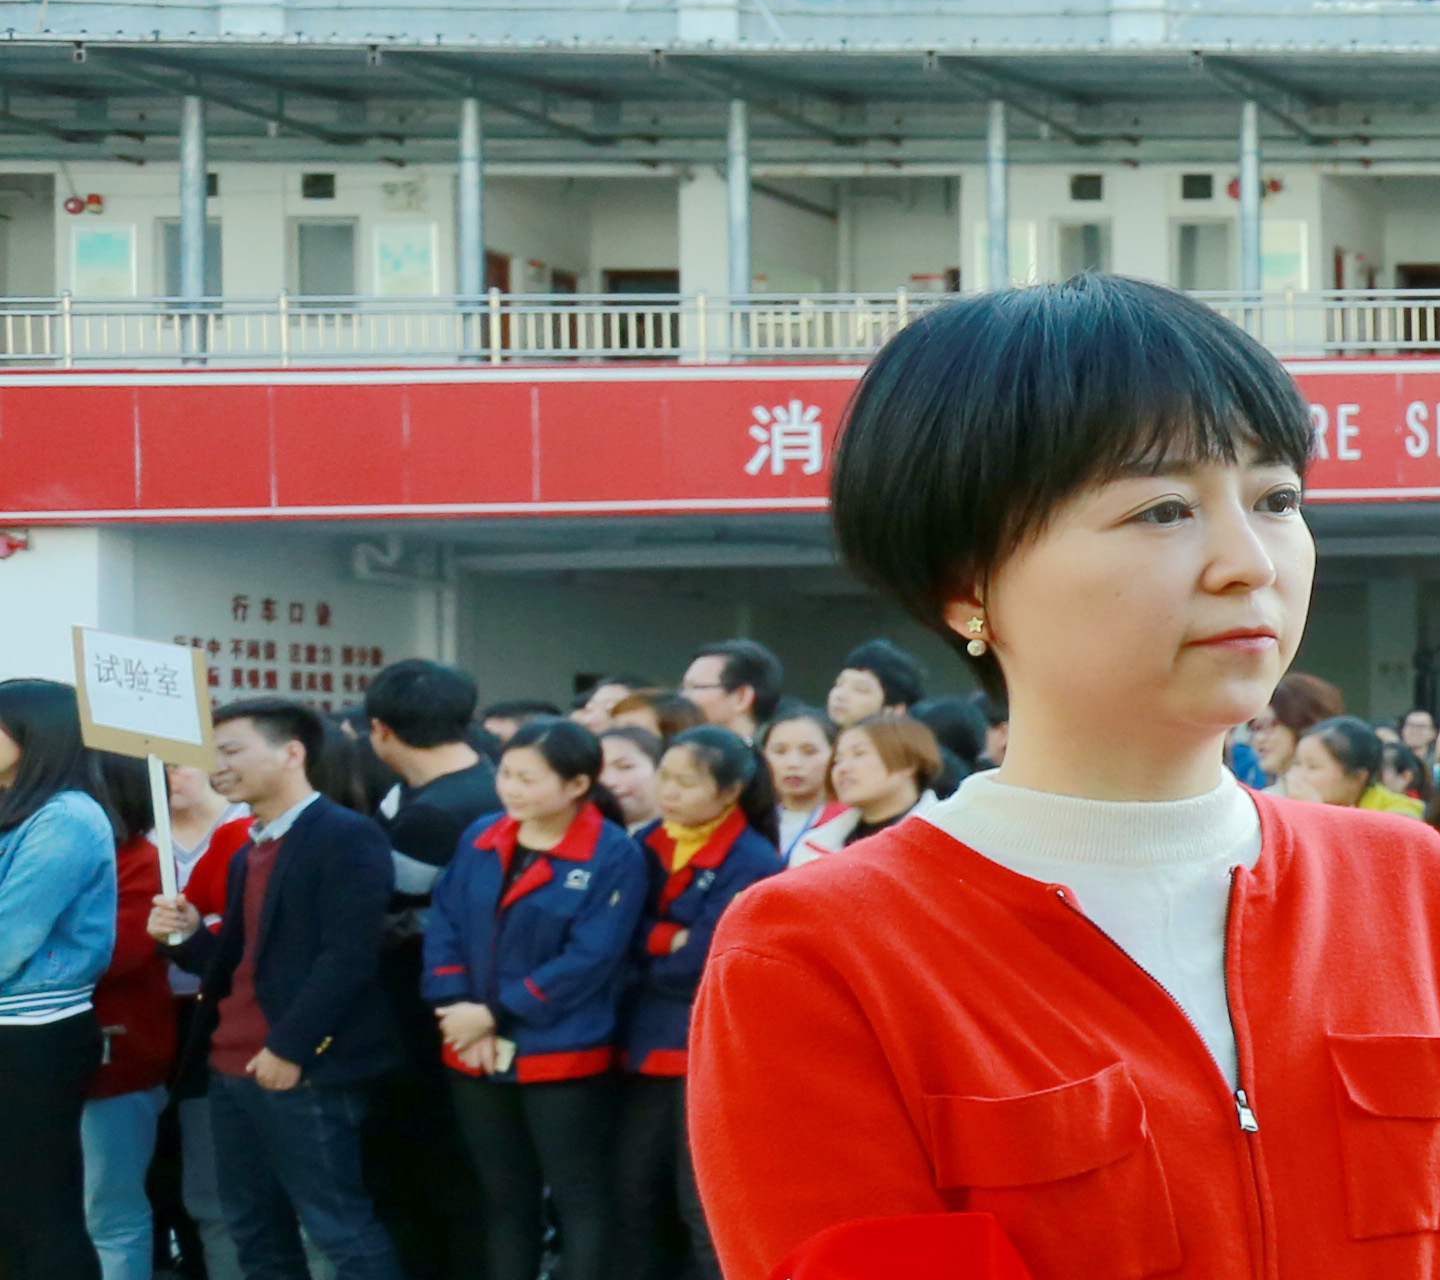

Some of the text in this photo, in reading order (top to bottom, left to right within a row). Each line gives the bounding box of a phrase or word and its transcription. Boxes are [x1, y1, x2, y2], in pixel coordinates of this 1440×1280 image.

[744, 400, 822, 476] 消
[94, 652, 182, 699] 试验室
